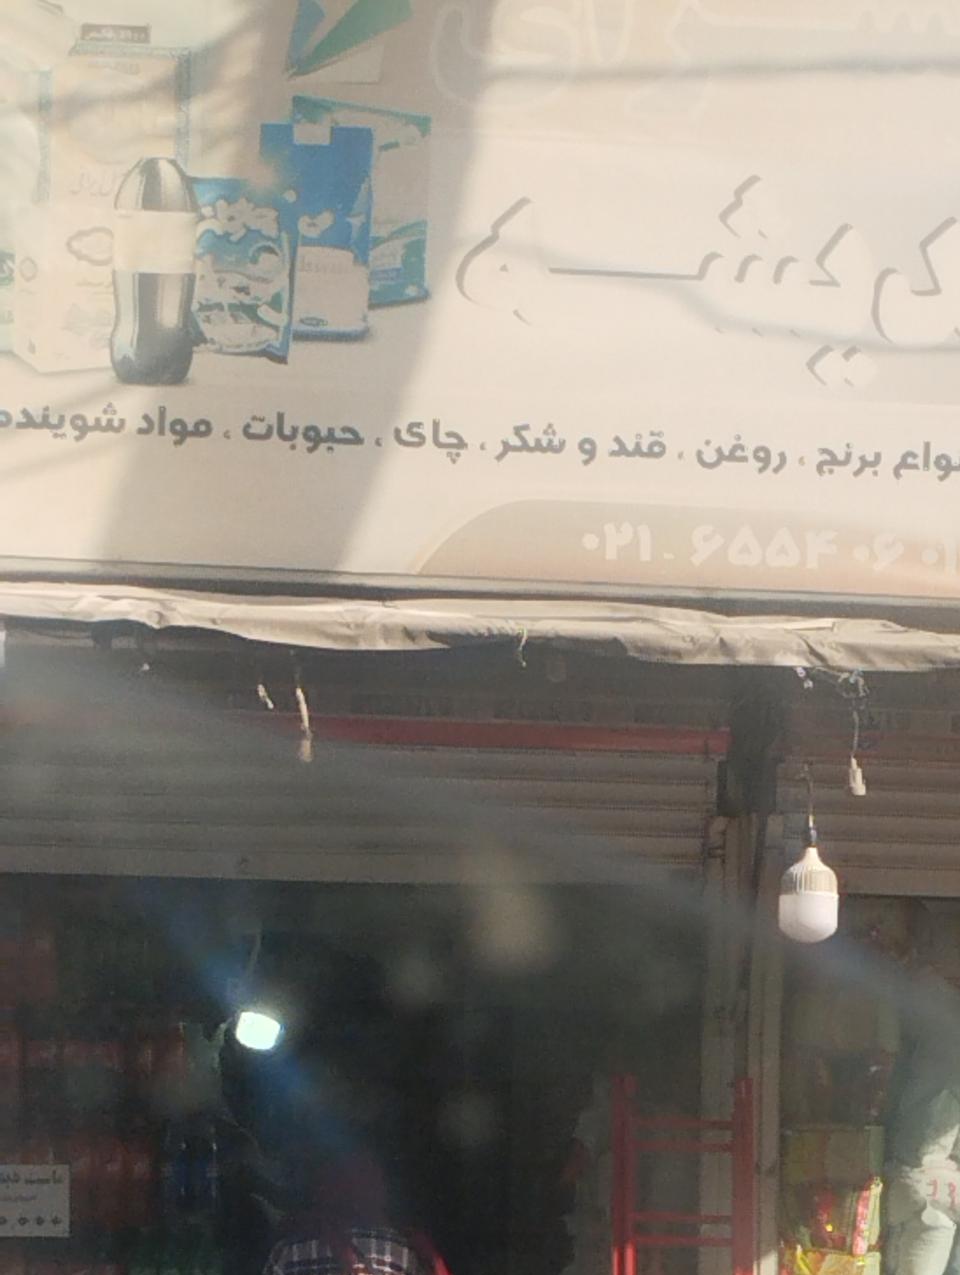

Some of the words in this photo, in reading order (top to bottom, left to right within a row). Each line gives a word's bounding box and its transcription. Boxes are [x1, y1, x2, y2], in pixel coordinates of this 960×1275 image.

[136, 406, 213, 446] مواد
[242, 411, 364, 453] حبوبات
[393, 418, 468, 464] چای
[494, 423, 566, 461] شکر
[608, 430, 667, 458] قند
[578, 436, 597, 466] و
[696, 434, 787, 474] روغن
[815, 442, 882, 478] برنج
